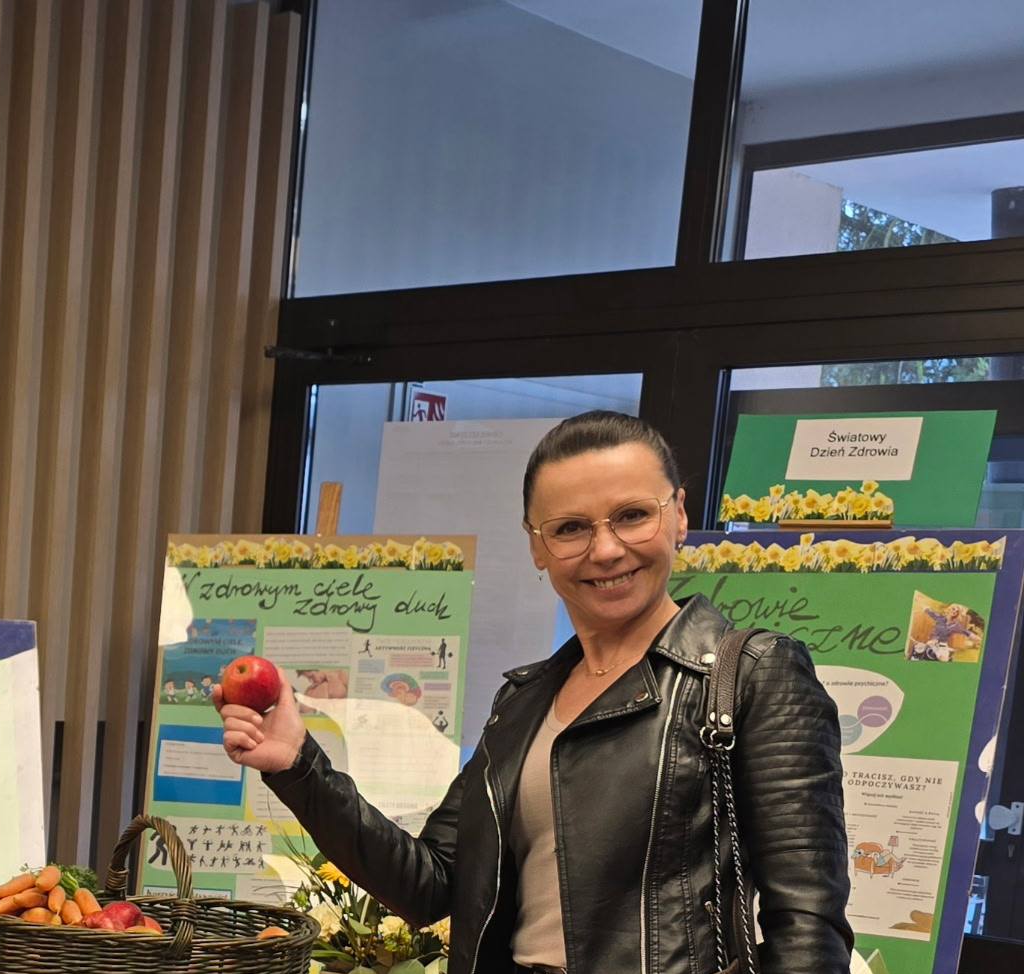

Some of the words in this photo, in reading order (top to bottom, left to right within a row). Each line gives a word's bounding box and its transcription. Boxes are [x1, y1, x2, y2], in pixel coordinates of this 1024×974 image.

[827, 430, 887, 444] Światowy
[810, 446, 845, 457] Dzień
[848, 446, 898, 457] Zdrowia
[199, 576, 302, 609] zdrowym
[313, 573, 381, 603] ciele
[394, 590, 454, 620] duch
[847, 779, 927, 791] ODPOCZYWASZ?
[852, 771, 897, 782] TRACISZ,
[900, 775, 921, 783] GDY
[924, 777, 943, 785] NIE
